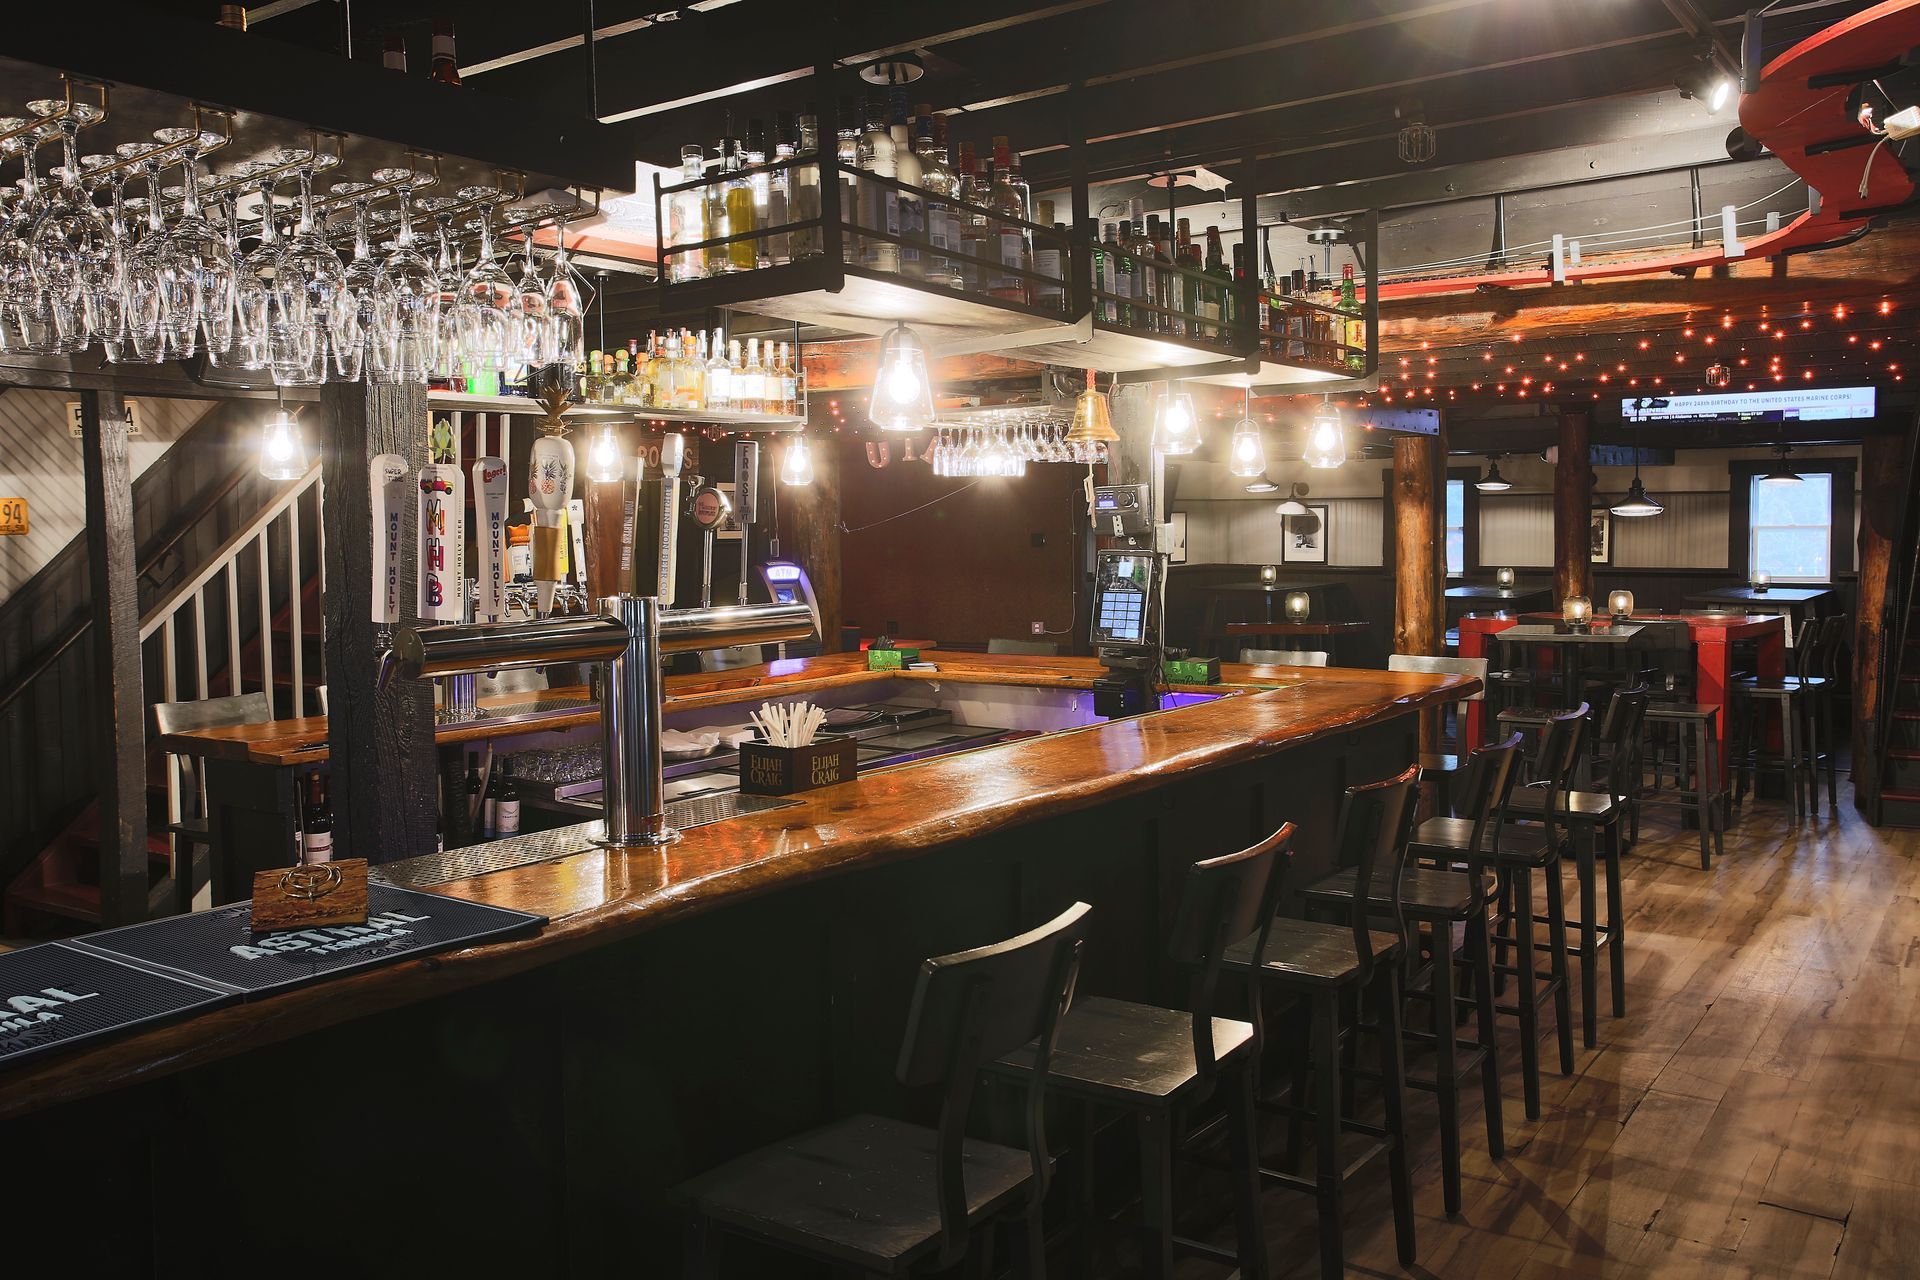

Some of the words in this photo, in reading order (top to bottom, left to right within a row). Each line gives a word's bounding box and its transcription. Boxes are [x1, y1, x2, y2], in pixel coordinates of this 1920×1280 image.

[482, 464, 507, 483] Lager!
[662, 485, 672, 549] BURLINGTON
[390, 512, 399, 561] MOUNT
[491, 511, 500, 558] MOUNT
[388, 566, 397, 615] HOLLY
[492, 562, 500, 608] HOLLY
[750, 768, 782, 786] CRAIG
[751, 754, 782, 772] ELIJAH
[811, 753, 839, 771] ELIJAH
[811, 768, 839, 785] CRAIG
